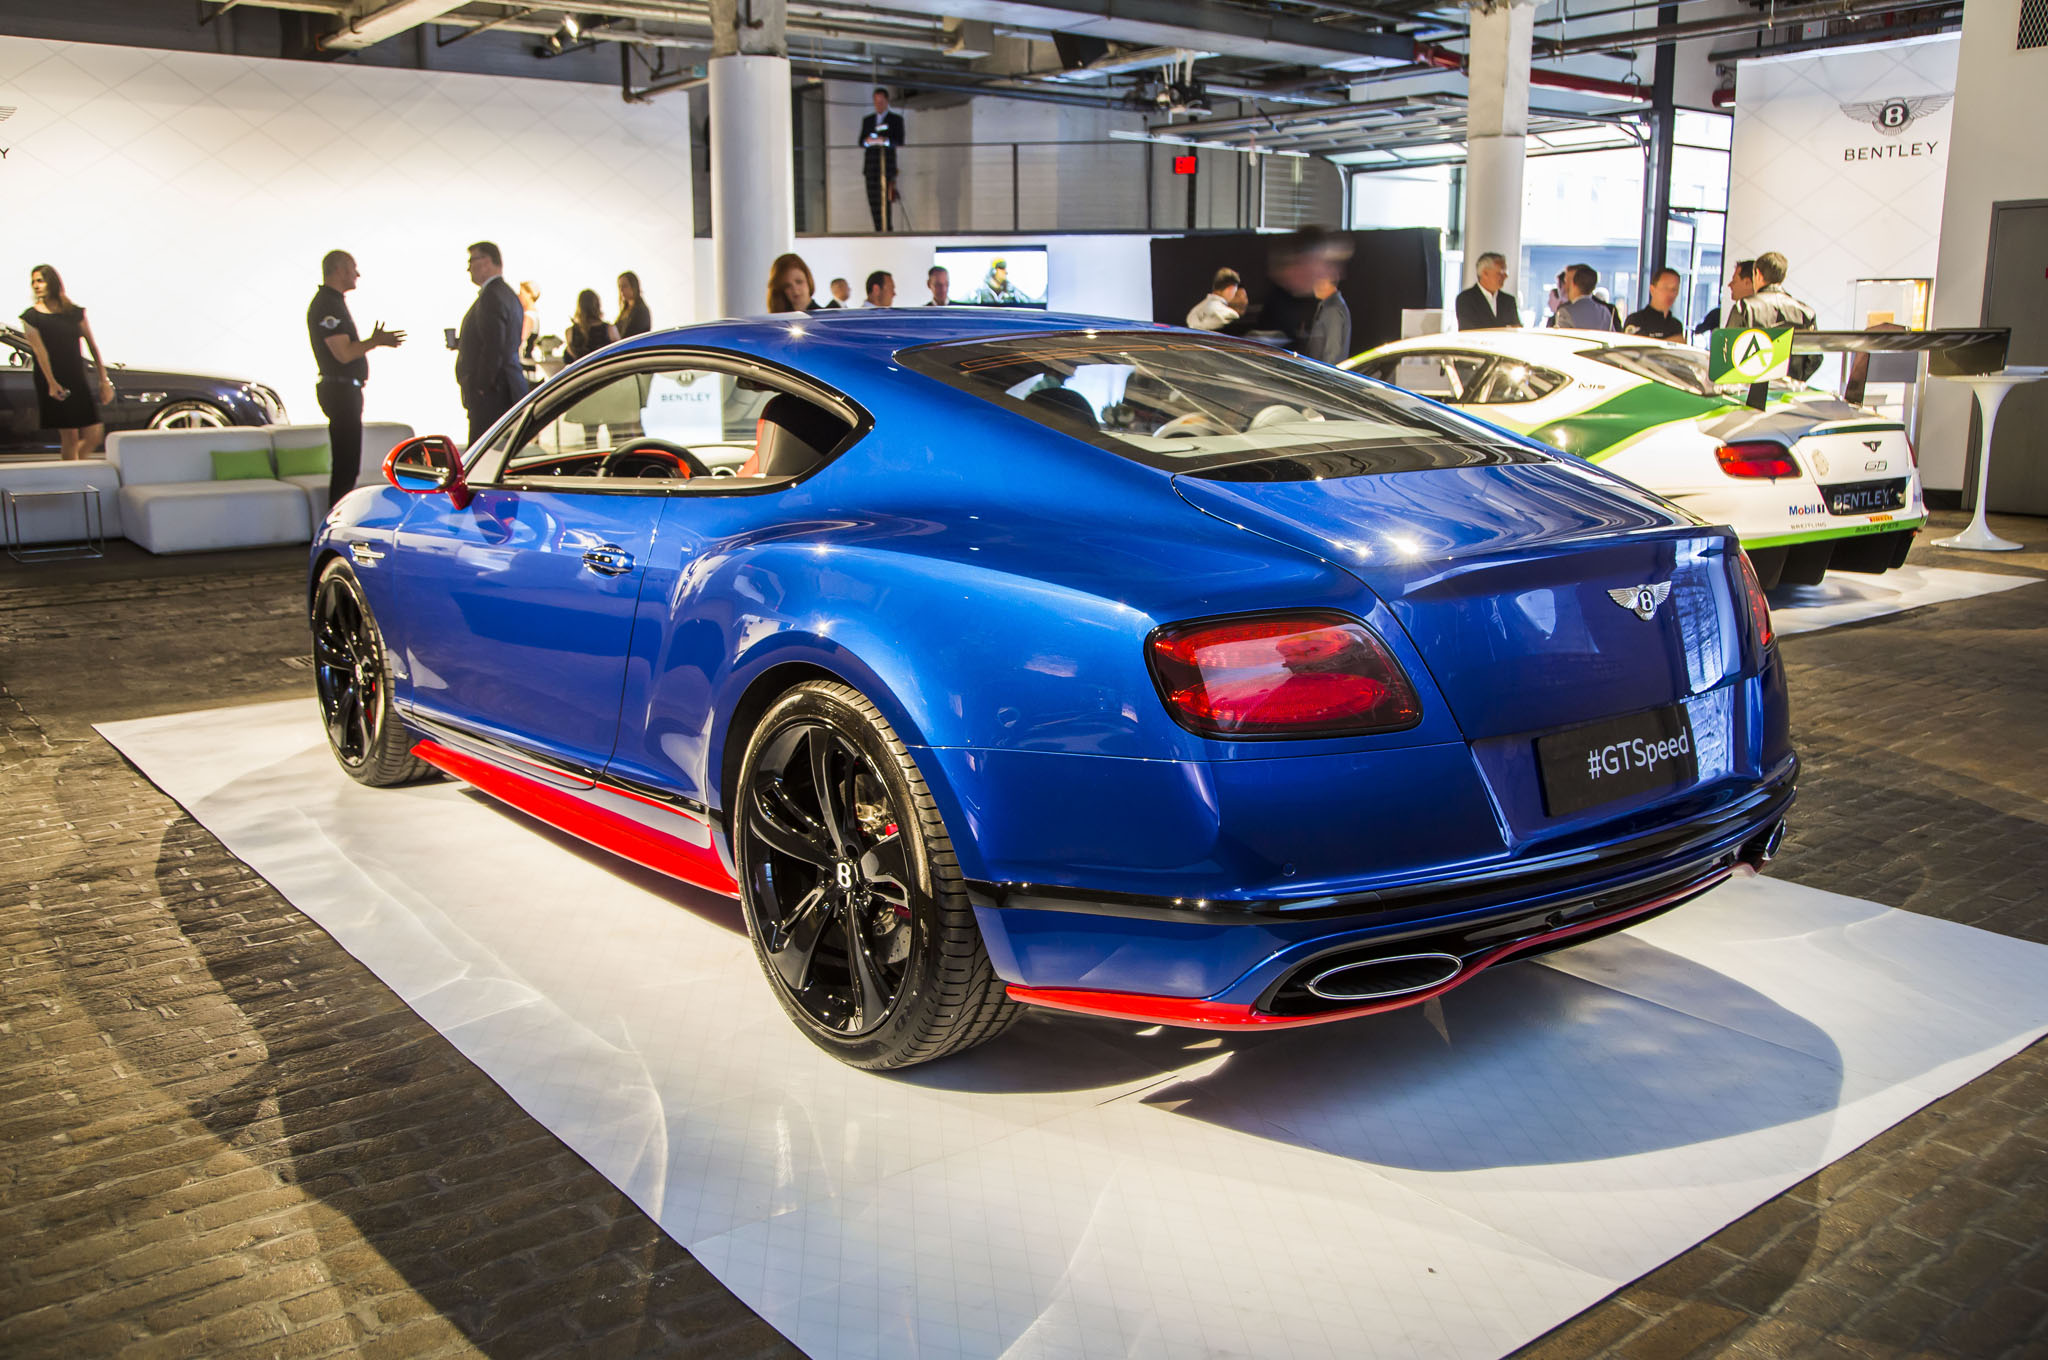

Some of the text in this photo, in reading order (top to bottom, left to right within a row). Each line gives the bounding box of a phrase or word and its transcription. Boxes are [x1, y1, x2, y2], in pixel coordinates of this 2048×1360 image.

[1844, 141, 1938, 161] BENTLEY
[661, 392, 711, 402] BENTLEY
[1834, 488, 1890, 510] BENTLEY
[1789, 503, 1816, 516] Mobil
[1587, 725, 1690, 780] #GTSpeed
